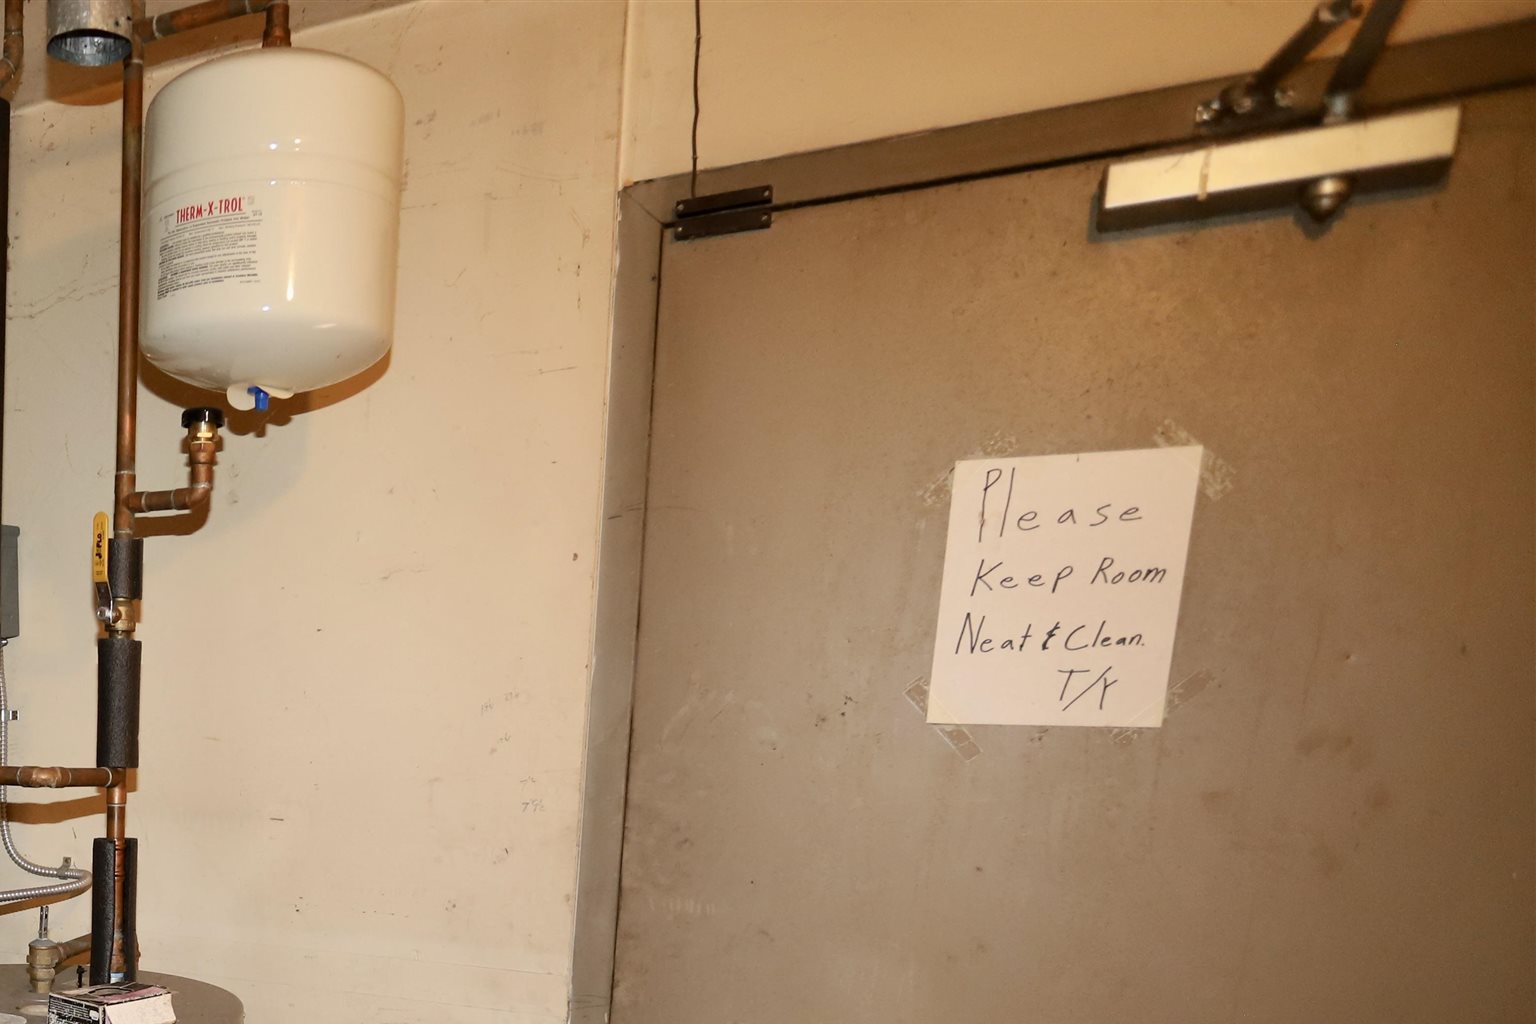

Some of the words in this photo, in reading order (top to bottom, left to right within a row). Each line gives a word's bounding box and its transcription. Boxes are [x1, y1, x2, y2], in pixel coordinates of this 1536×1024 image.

[176, 196, 244, 224] THERM-X-TROL
[977, 467, 1143, 543] Please
[970, 559, 1074, 597] Keep
[1089, 557, 1167, 585] Room
[954, 612, 1032, 655] Neat
